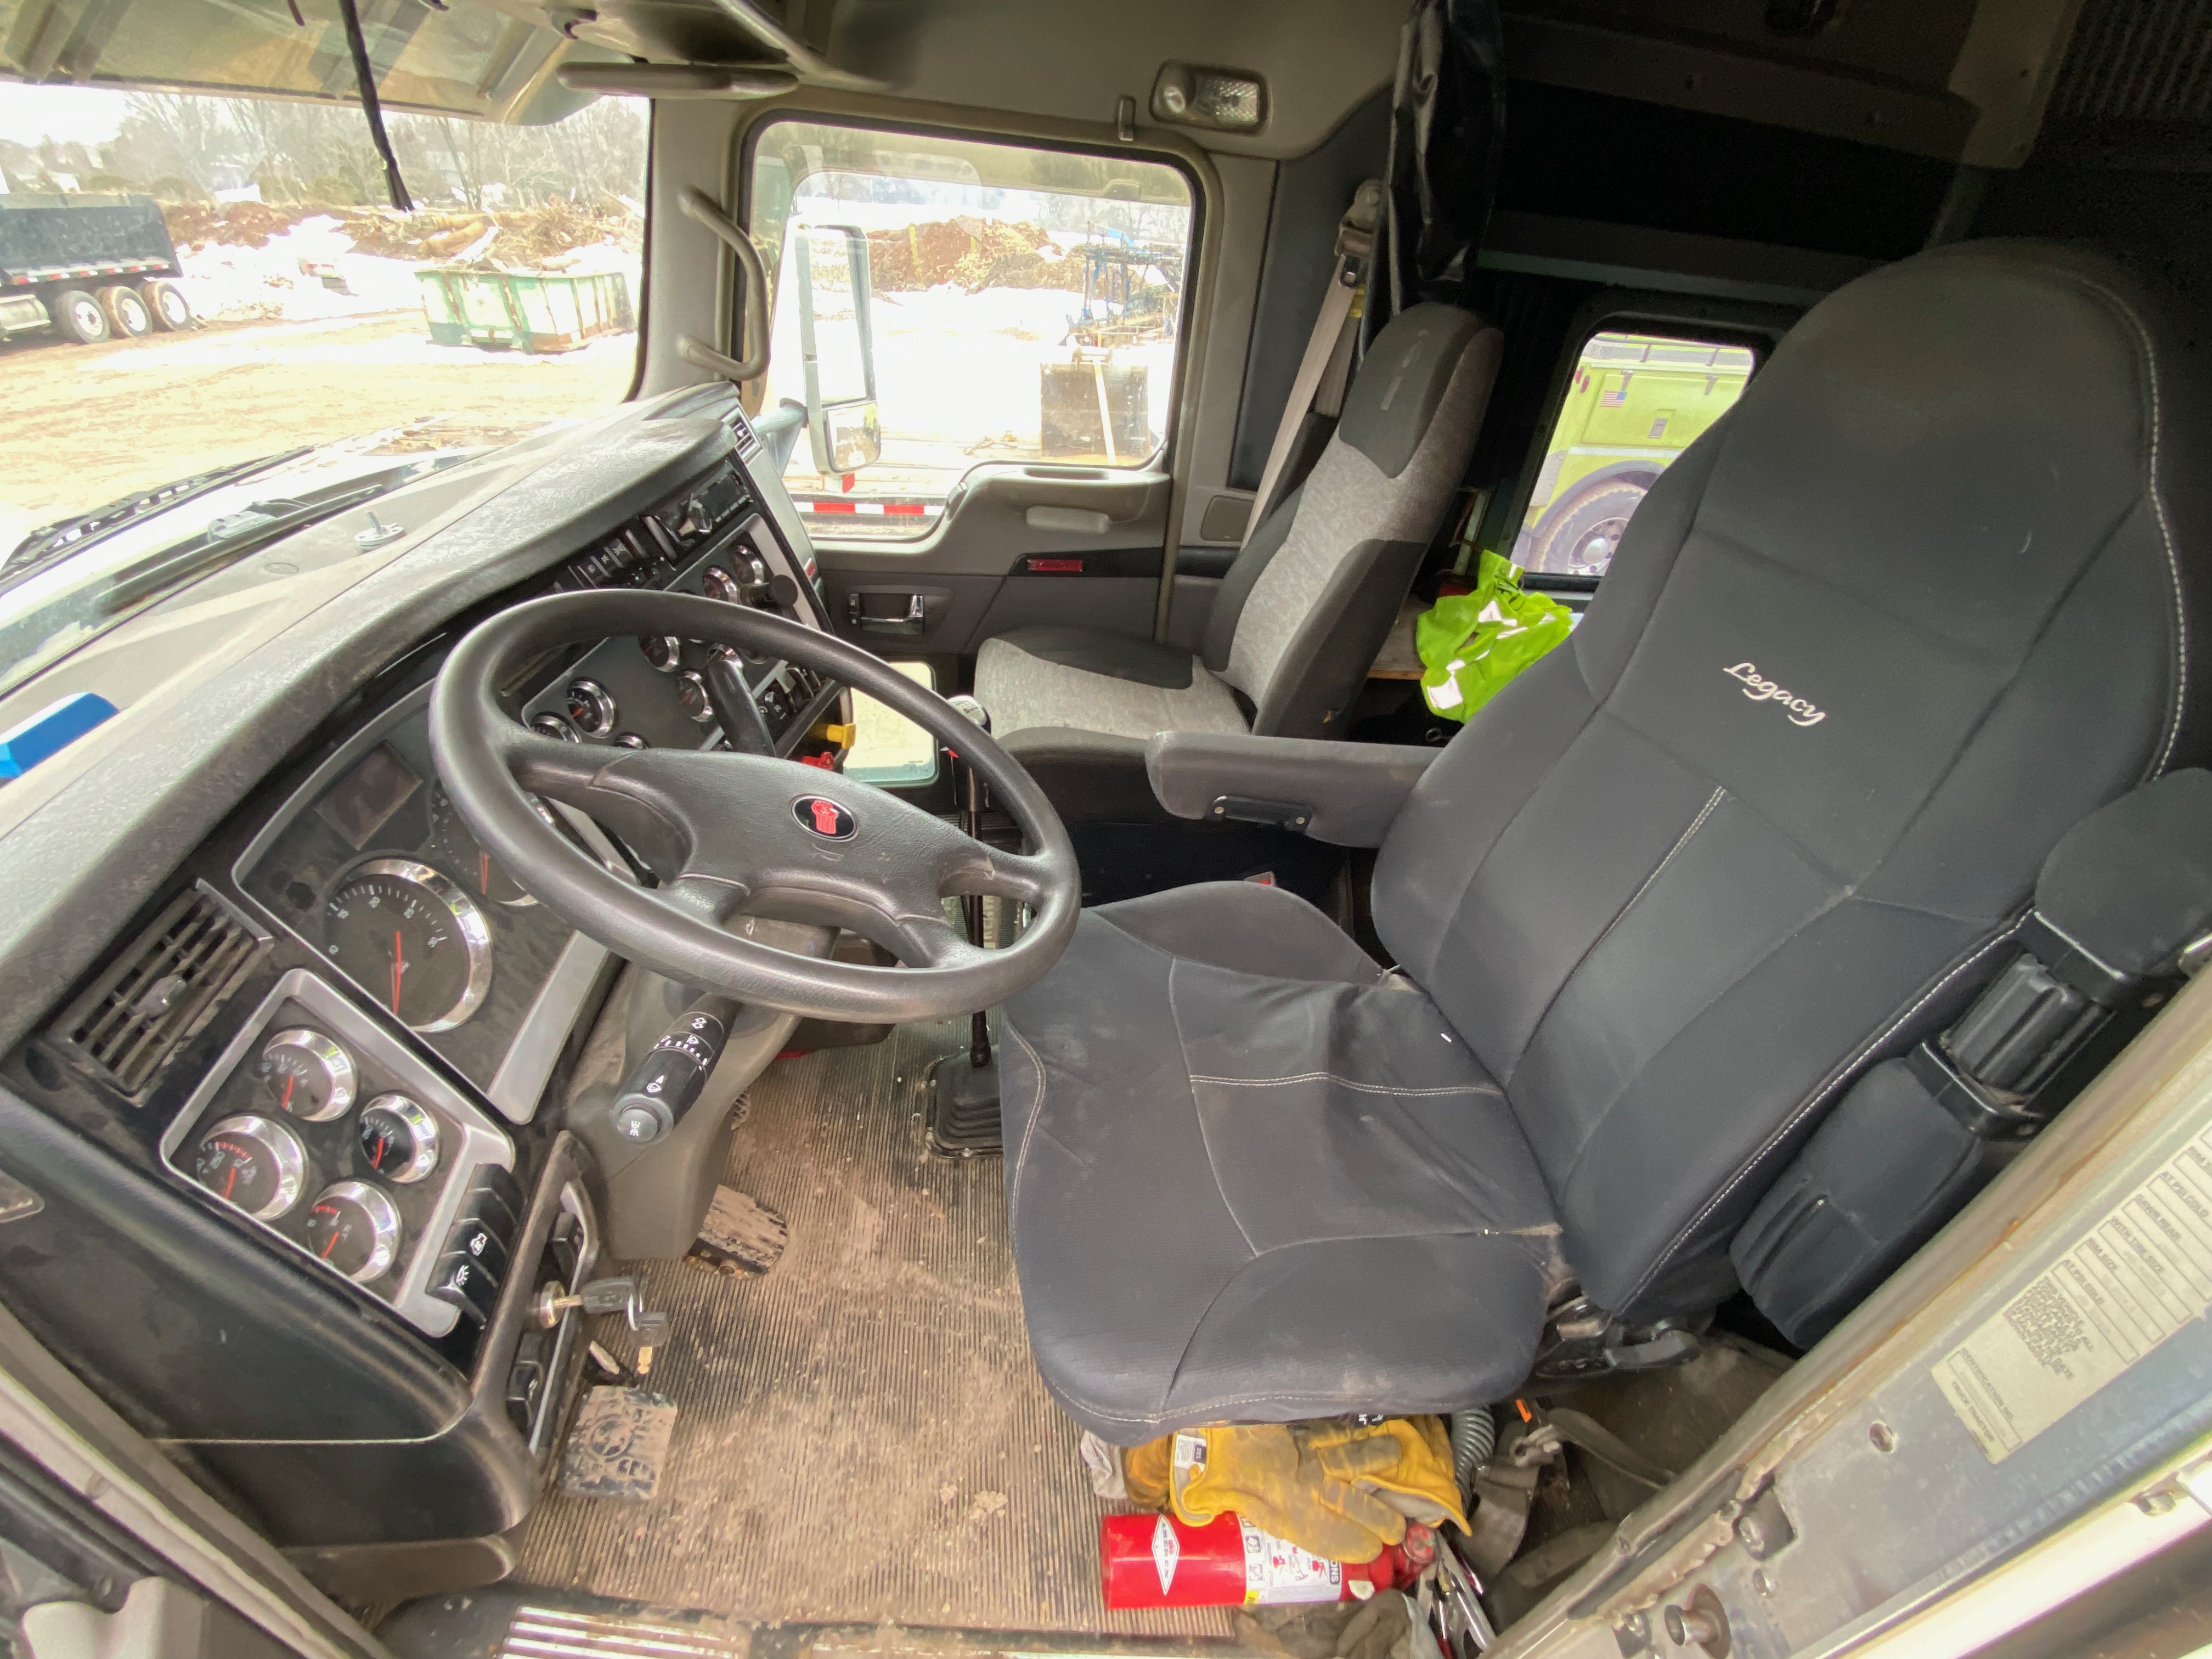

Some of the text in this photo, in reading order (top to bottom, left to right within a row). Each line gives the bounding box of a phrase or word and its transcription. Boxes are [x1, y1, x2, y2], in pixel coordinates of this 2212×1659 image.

[1723, 662, 1826, 727] Legacy
[2101, 1254, 2117, 1272] SIZE
[2147, 1255, 2163, 1274] SIZE
